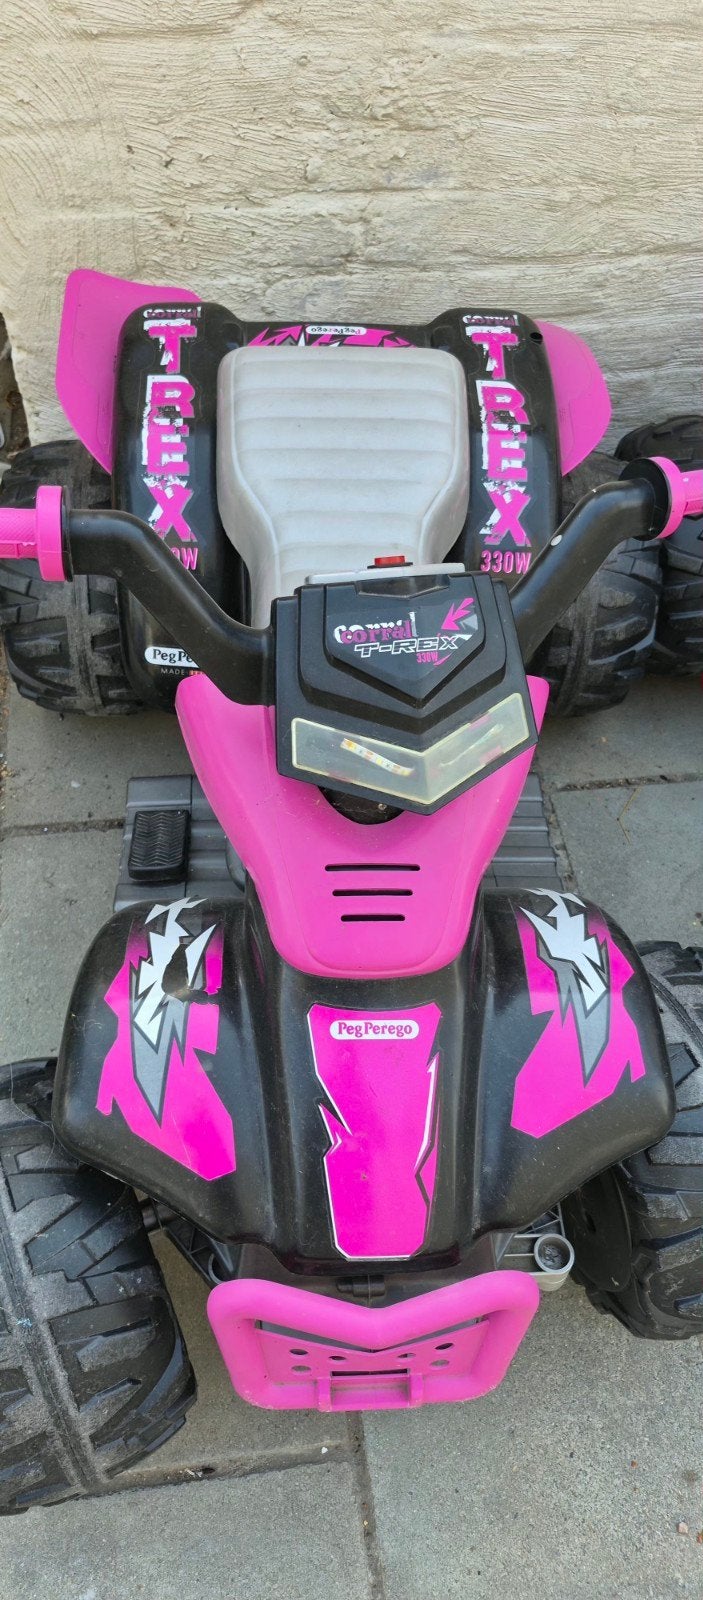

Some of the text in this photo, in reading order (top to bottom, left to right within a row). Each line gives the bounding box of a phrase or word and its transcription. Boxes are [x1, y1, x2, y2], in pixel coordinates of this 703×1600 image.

[480, 549, 532, 575] 330W
[333, 611, 419, 645] corral
[354, 635, 459, 659] T-REX
[416, 651, 439, 664] 330W
[160, 668, 185, 676] MADE
